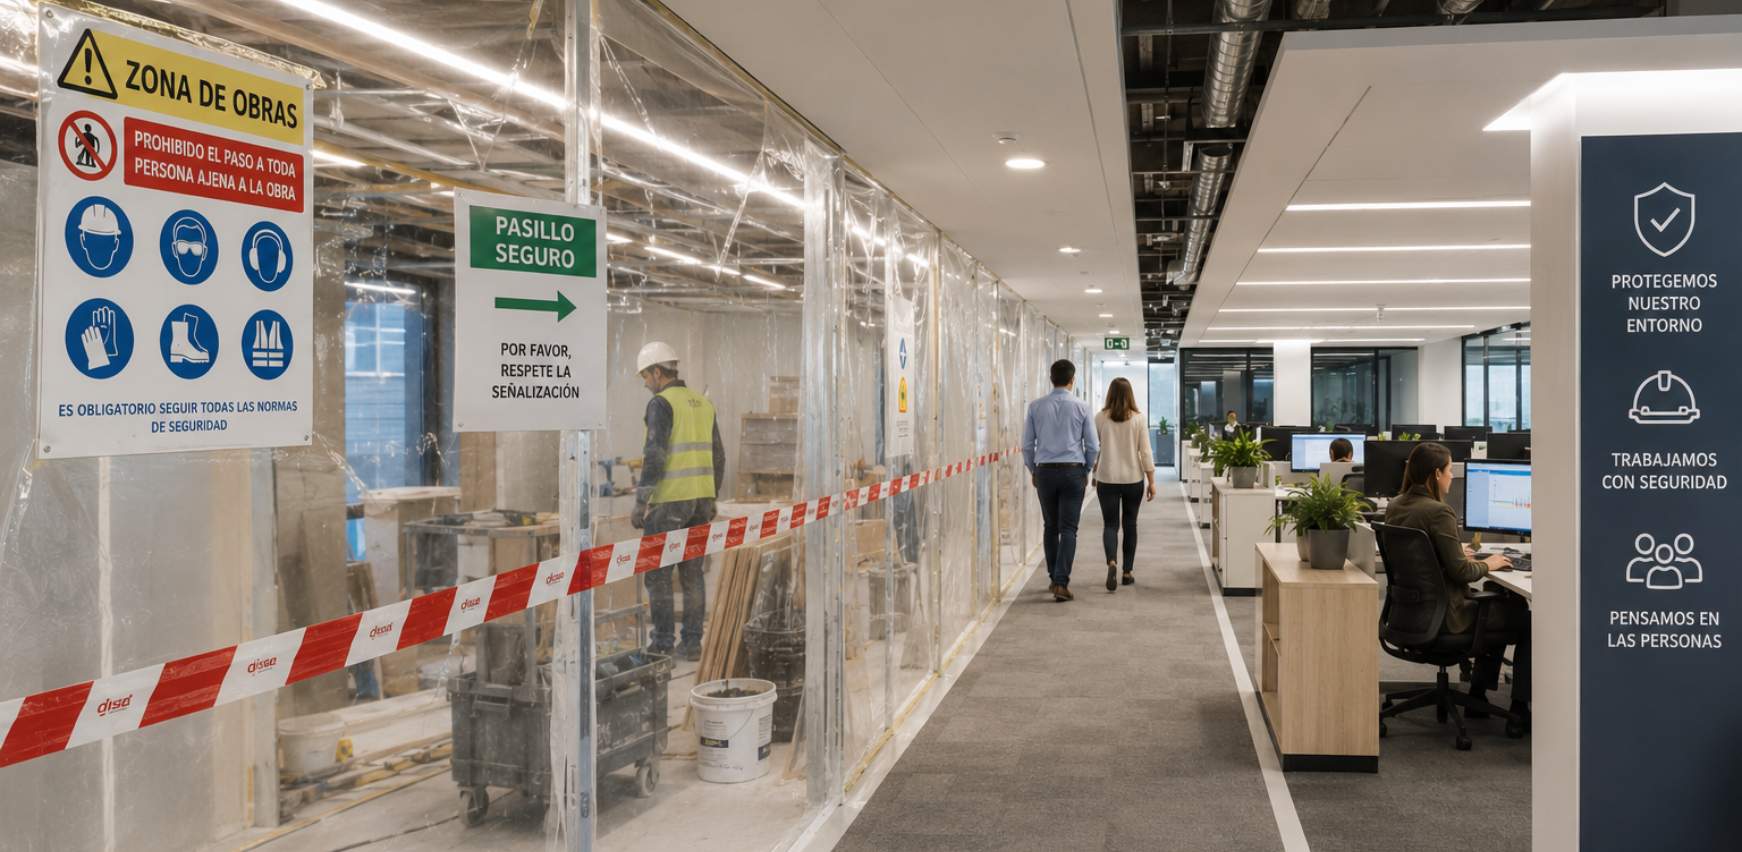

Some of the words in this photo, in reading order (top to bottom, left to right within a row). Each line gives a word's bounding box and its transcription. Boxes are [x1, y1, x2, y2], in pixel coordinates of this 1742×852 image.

[126, 60, 192, 103] ZONA
[200, 80, 226, 111] DE
[233, 89, 297, 128] OBRAS
[135, 130, 204, 159] PROHIBIDO
[208, 146, 221, 162] EL
[224, 149, 253, 169] PASO
[256, 157, 264, 171] A
[267, 158, 295, 178] TODA
[135, 157, 194, 183] PERSONA
[198, 170, 235, 190] AJENA
[239, 177, 246, 192] A
[250, 179, 263, 195] LA
[267, 182, 295, 200] OBRA
[496, 216, 574, 241] PASILLO
[496, 243, 574, 268] SEGURO
[1612, 274, 1717, 288] PROTEGEMOS
[1629, 296, 1700, 310] NUESTRO
[1628, 318, 1702, 332] ENTORNO
[501, 343, 526, 356] POR
[531, 344, 571, 359] FAVOR,
[501, 364, 552, 377] RESPETE
[557, 366, 571, 378] LA
[492, 382, 579, 398] SEÑALIZACIÓN
[59, 404, 73, 416] ES
[78, 403, 156, 416] OBLIGATORIO
[160, 402, 197, 414] SEGUIR
[201, 402, 234, 413] TODAS
[237, 401, 254, 412] LAS
[257, 401, 297, 412] NORMAS
[152, 421, 165, 433] DE
[169, 420, 227, 432] SEGURIDAD
[1612, 453, 1717, 467] TRABAJAMOS
[1603, 475, 1634, 489] CON
[1640, 475, 1727, 489] SEGURIDAD
[1611, 611, 1694, 625] PENSAMOS
[1700, 612, 1719, 625] EN
[1608, 633, 1635, 647] LAS
[1641, 634, 1721, 648] PERSONAS
